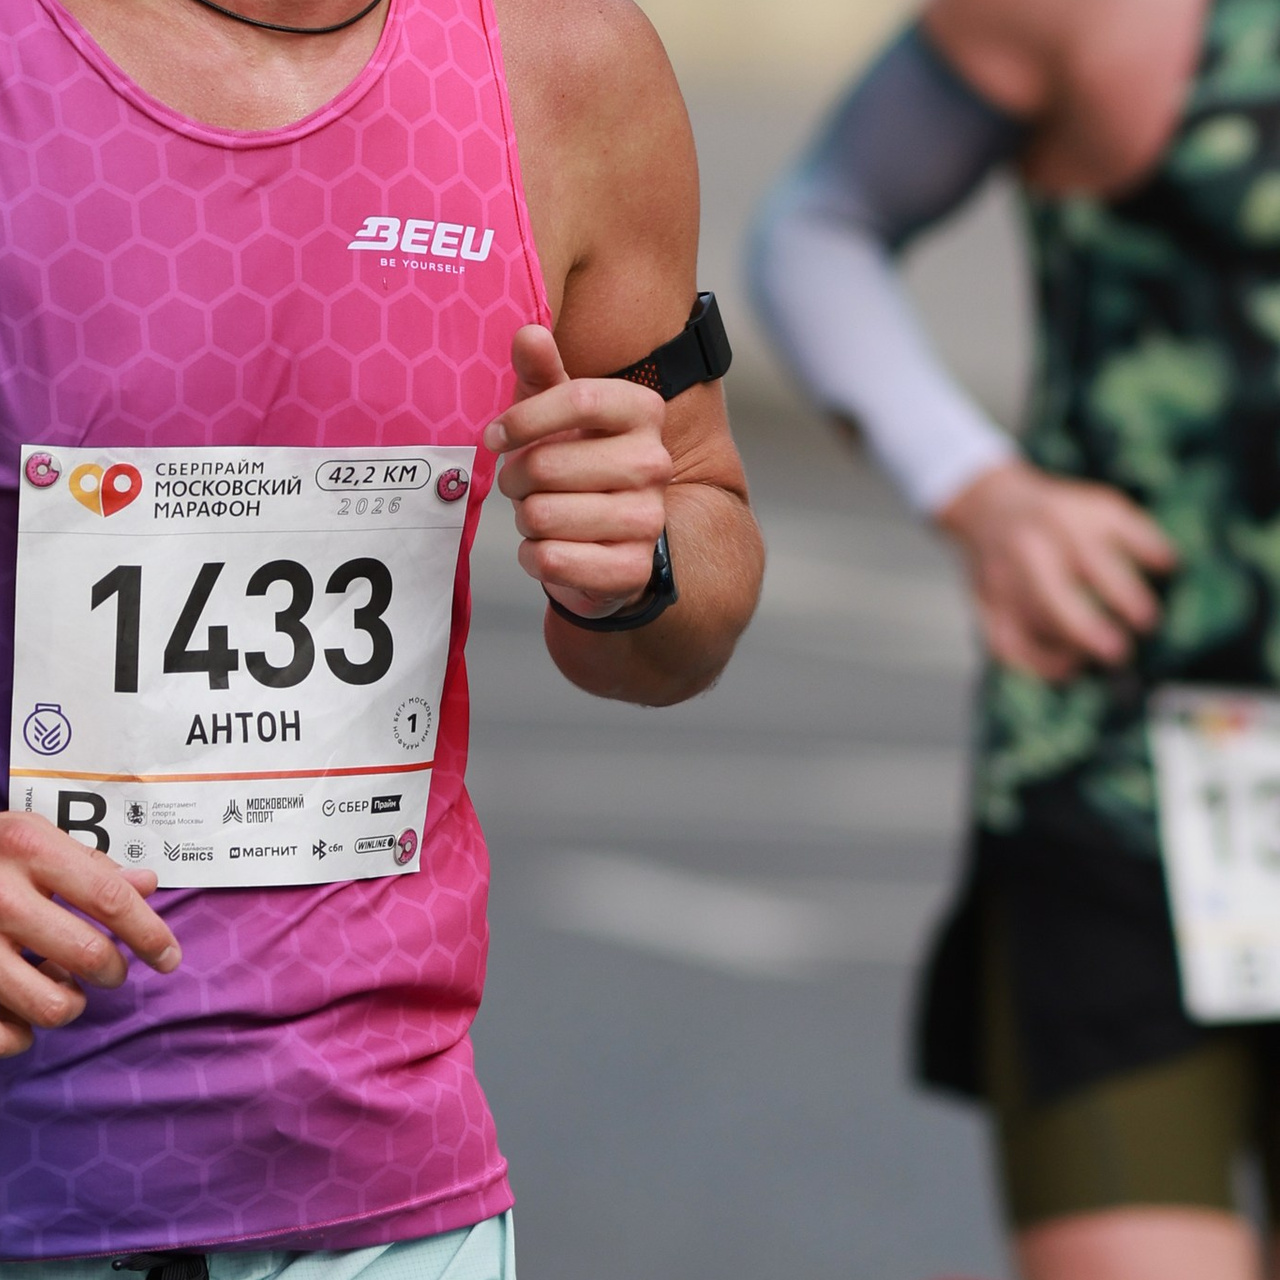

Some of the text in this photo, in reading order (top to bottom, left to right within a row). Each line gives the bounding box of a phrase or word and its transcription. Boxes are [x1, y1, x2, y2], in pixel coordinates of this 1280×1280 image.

[347, 216, 495, 262] BEEU
[380, 258, 466, 275] BE YOURSELF
[155, 459, 265, 476] СБЕРПРАЙМ
[328, 465, 375, 486] 42,2
[154, 476, 302, 498] МОСКОВСКИЙ
[154, 500, 261, 519] МАРАФОН
[337, 496, 402, 516] 2026
[90, 557, 395, 694] 1433
[185, 710, 302, 746] АНТОН
[407, 713, 418, 733] 1
[25, 786, 33, 813] ORRAL
[246, 794, 305, 811] МОСКОВСКИЙ
[338, 799, 397, 813] СБЕР Прайм
[57, 790, 111, 855] B
[151, 810, 176, 818] спорта
[151, 817, 204, 826] города Москвы
[246, 810, 274, 824] СПОРТ
[357, 838, 388, 851] WINLINE
[181, 852, 214, 862] BRICS
